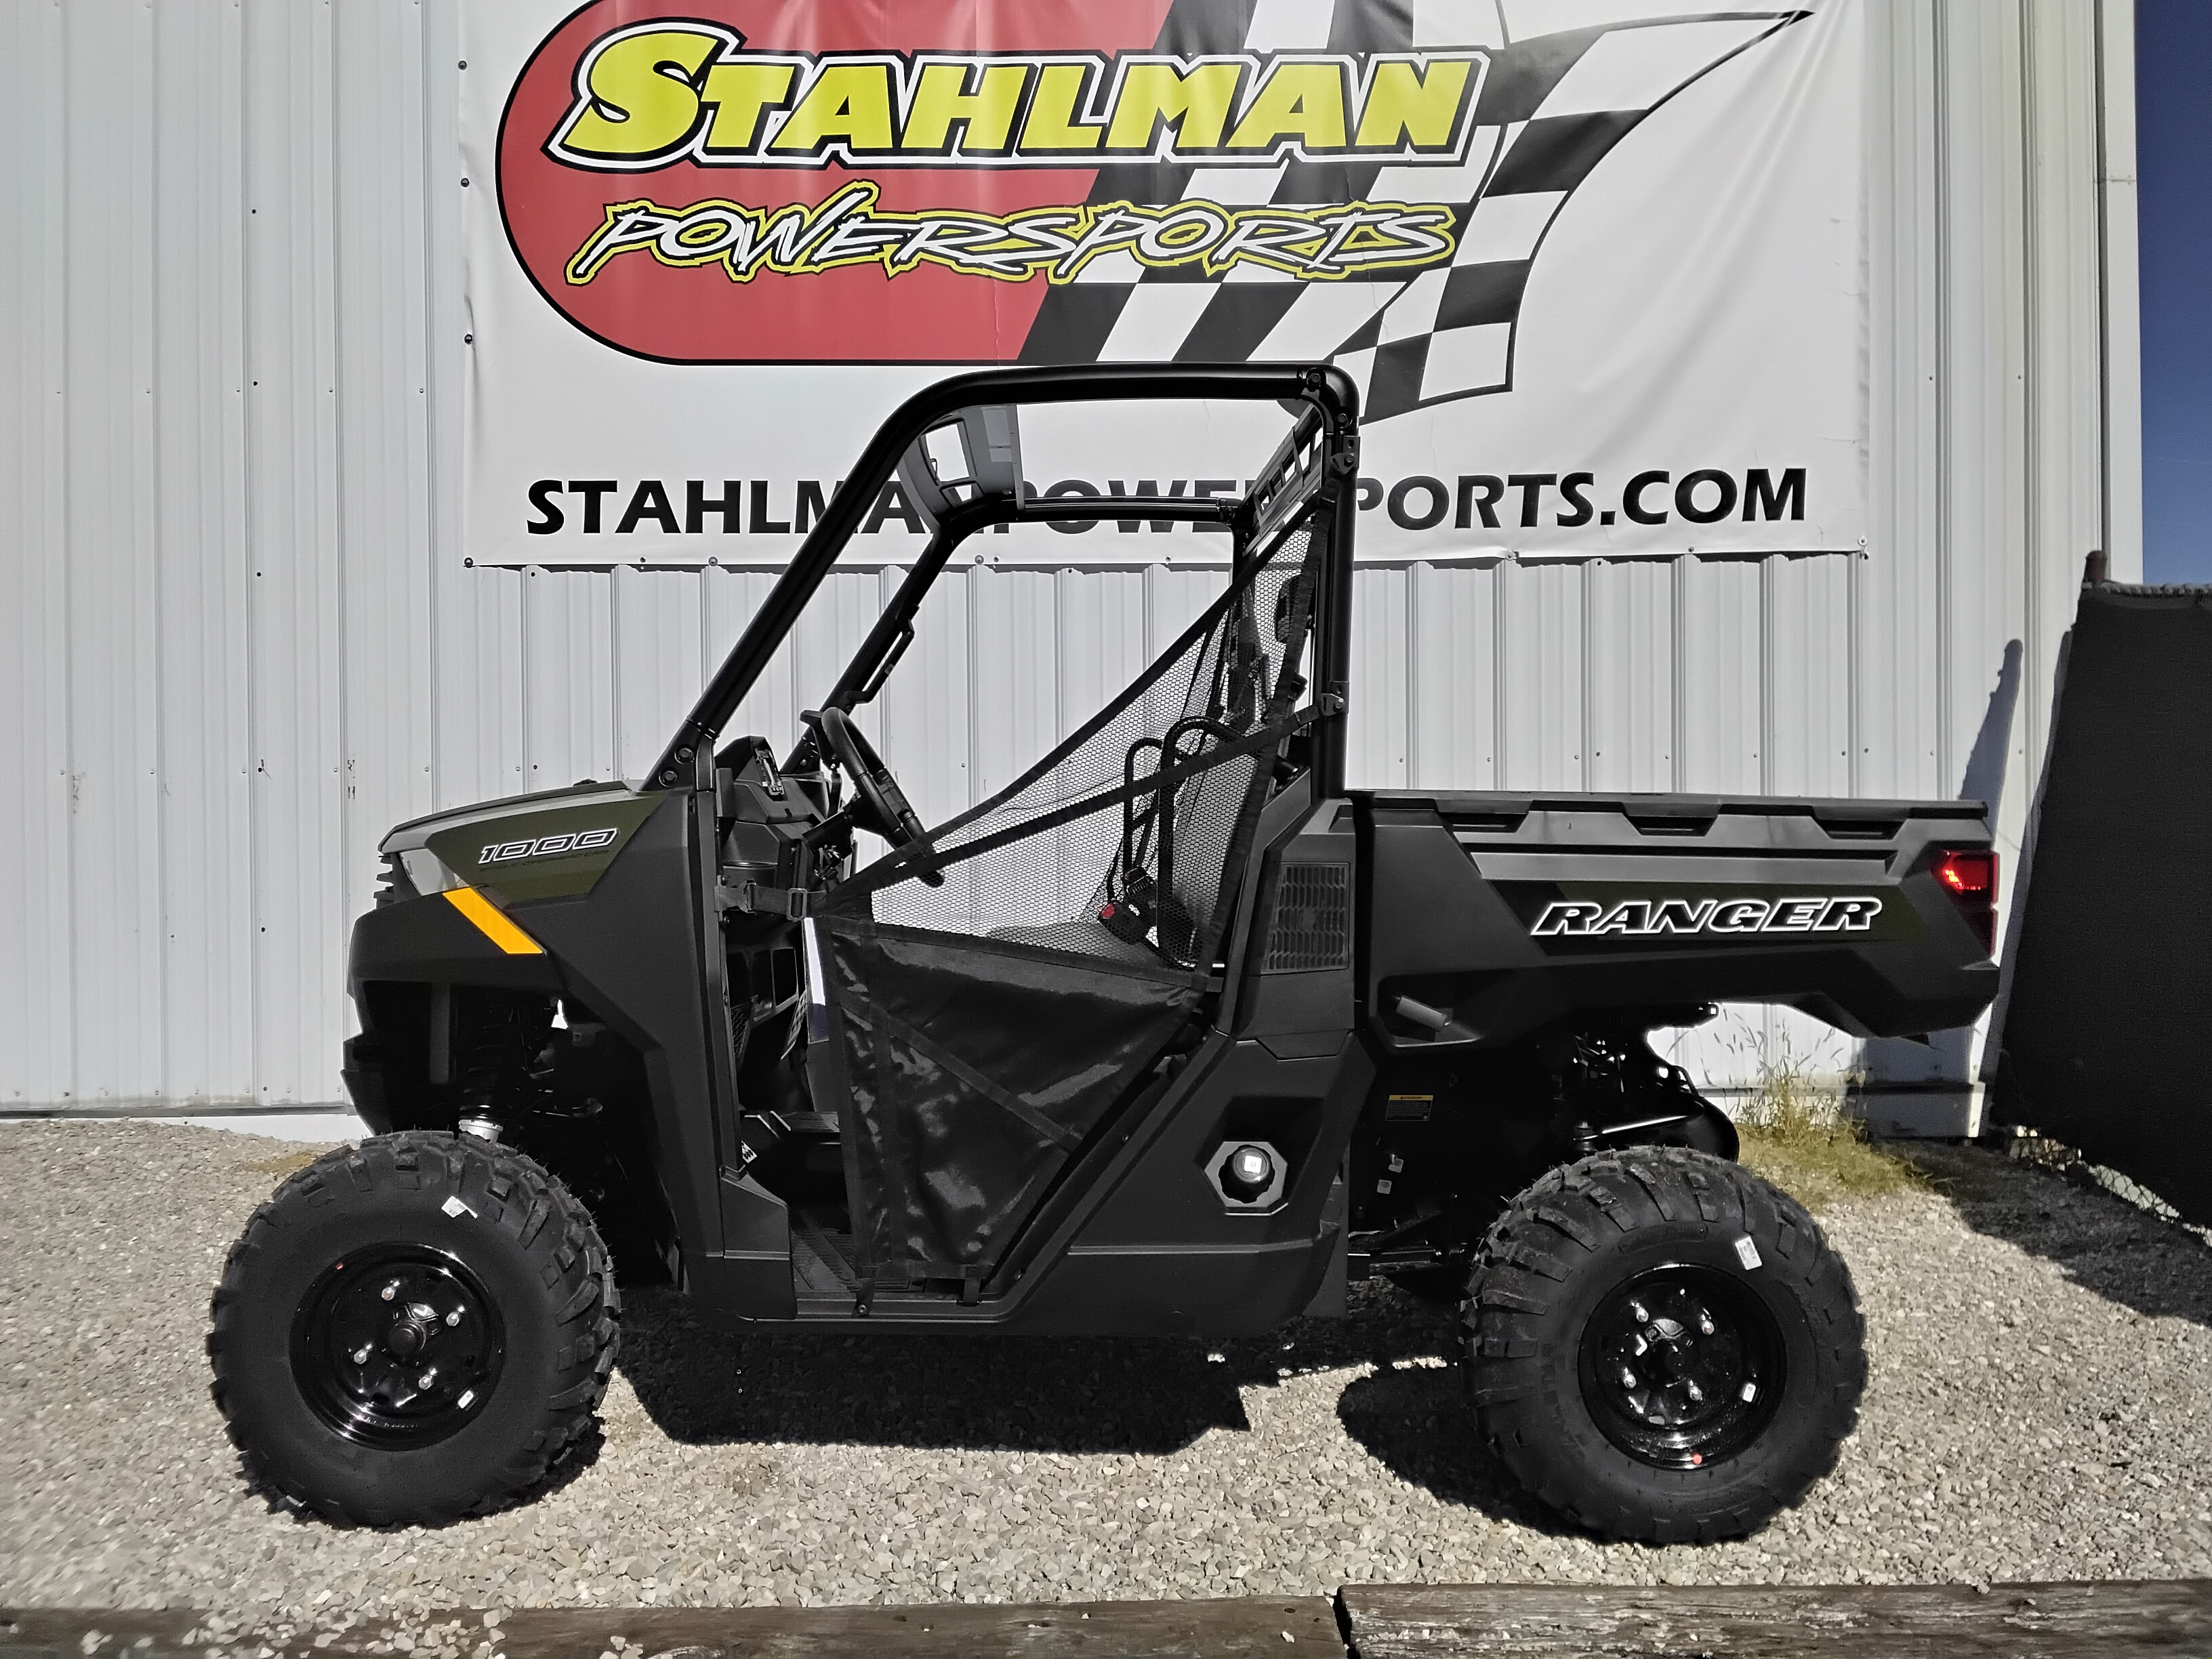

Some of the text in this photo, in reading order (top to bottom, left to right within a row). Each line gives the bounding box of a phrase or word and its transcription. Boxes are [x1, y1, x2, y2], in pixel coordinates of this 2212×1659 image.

[548, 22, 1490, 169] STAHLMAN
[568, 180, 1455, 283] POWERSPORTS
[478, 827, 618, 865] 1000
[1530, 897, 1883, 935] RANGER
